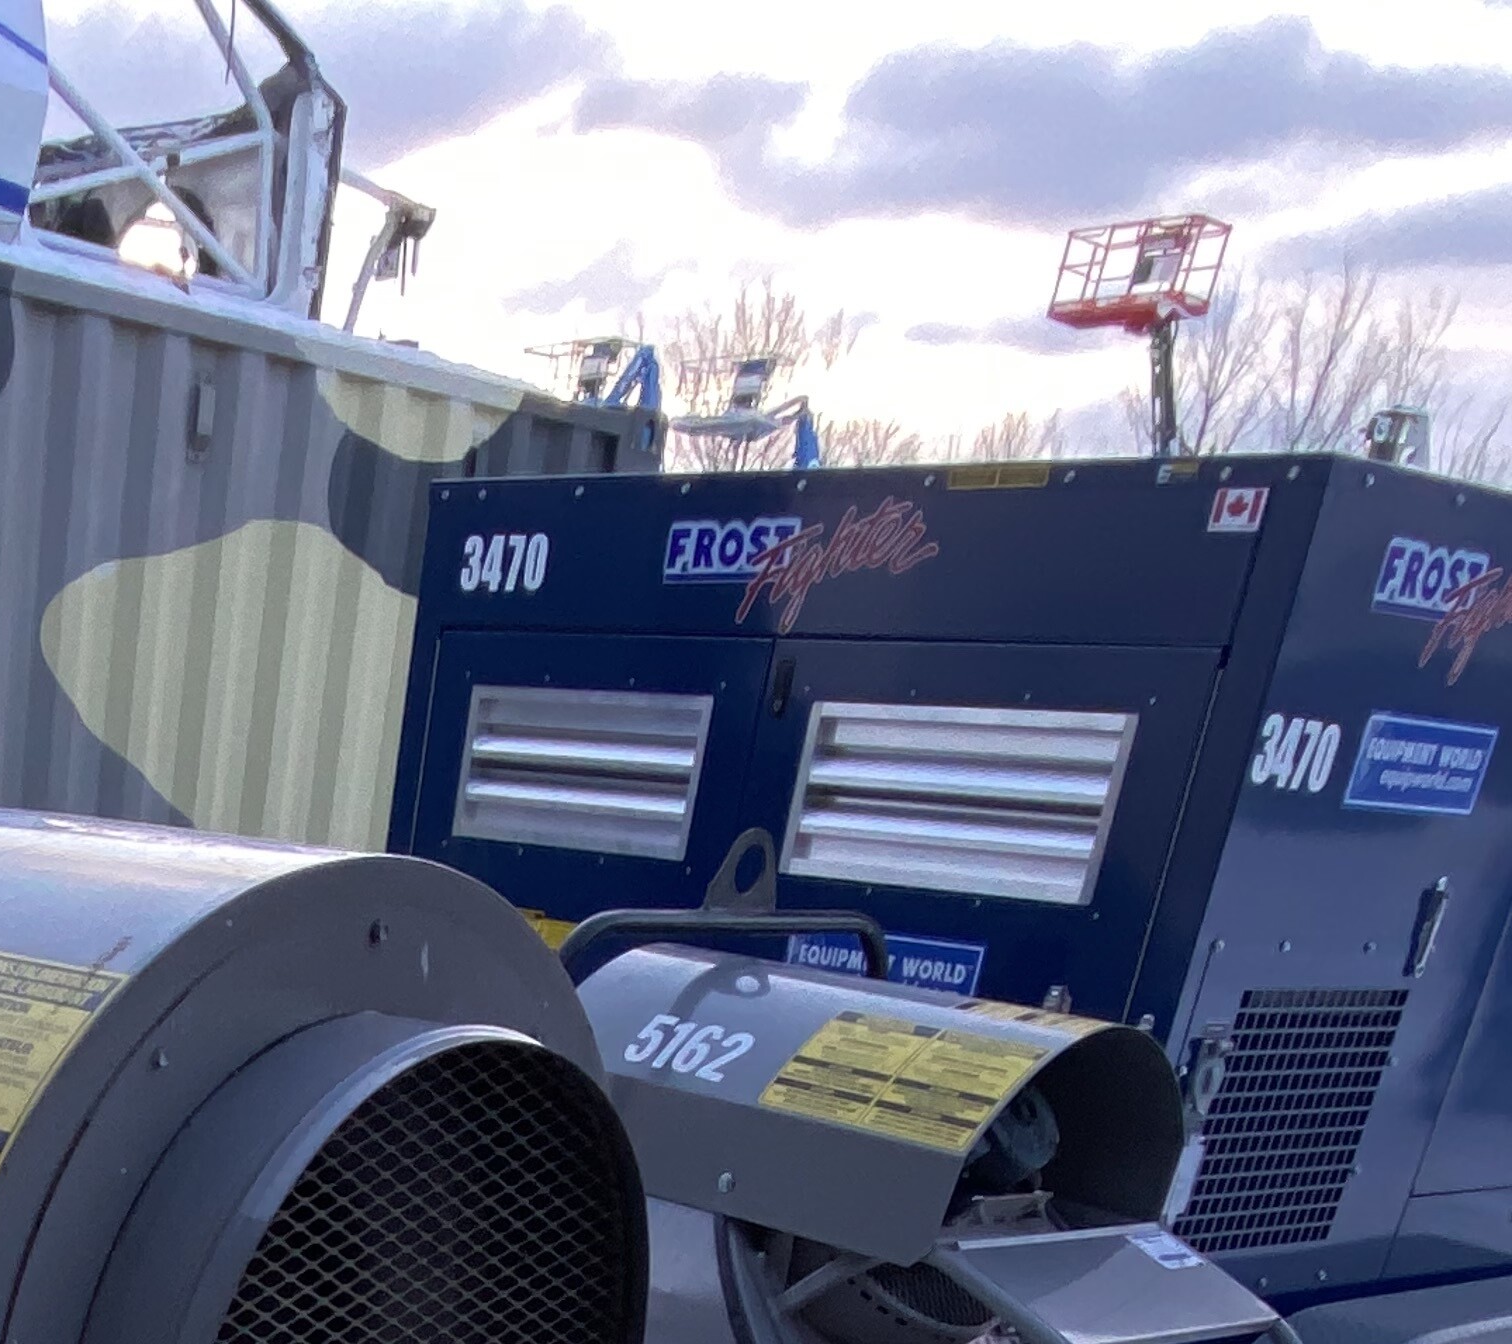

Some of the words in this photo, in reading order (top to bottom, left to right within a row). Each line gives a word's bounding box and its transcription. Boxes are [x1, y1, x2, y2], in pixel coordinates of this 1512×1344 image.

[459, 533, 549, 593] 3470
[667, 524, 797, 569] FROST
[735, 495, 939, 634] Fighter
[1376, 545, 1485, 609] FROST
[1252, 713, 1341, 793] 3470
[1366, 737, 1439, 766] EQUIPMENT
[1438, 744, 1484, 771] WORLD
[798, 943, 897, 974] EQUIPMT
[902, 956, 966, 985] WORLD
[624, 1013, 756, 1083] 5162
